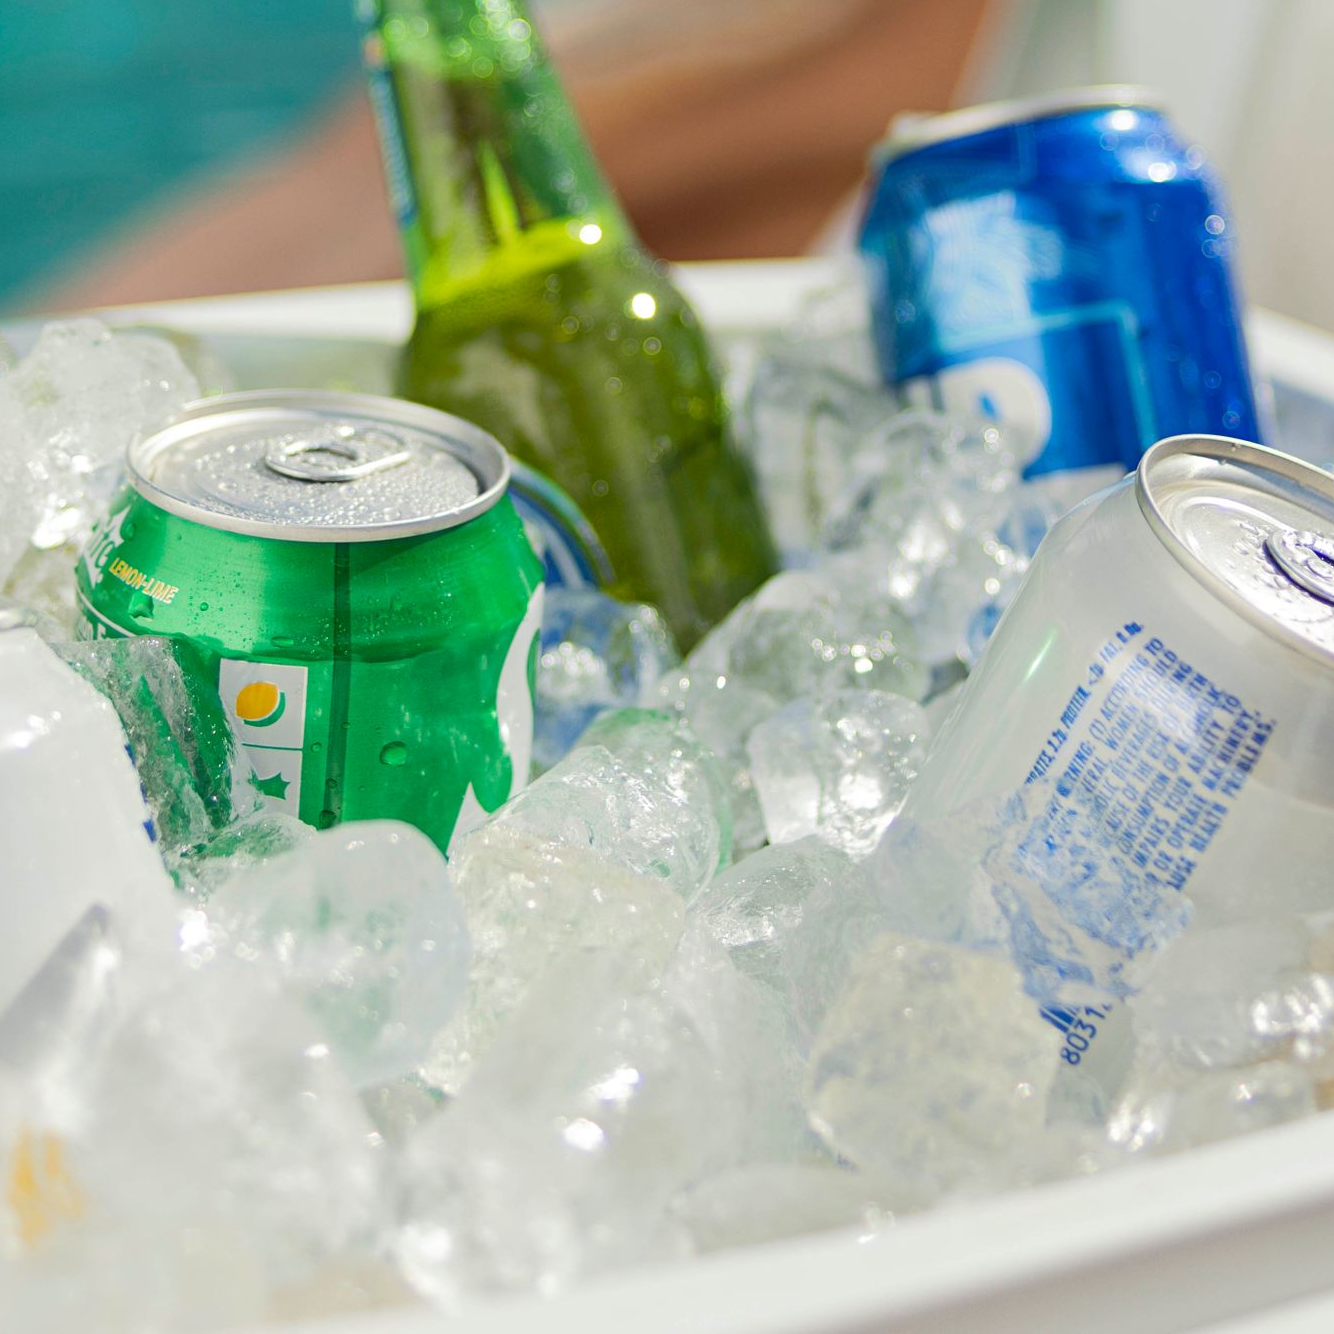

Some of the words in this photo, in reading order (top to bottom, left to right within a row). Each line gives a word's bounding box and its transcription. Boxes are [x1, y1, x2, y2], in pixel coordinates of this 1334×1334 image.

[109, 557, 180, 604] LEMON-LIME
[1098, 653, 1150, 722] ACCORDING
[1143, 635, 1165, 656] TO
[1102, 702, 1139, 751] WOMEN
[1133, 648, 1178, 702] SHOULD
[1113, 769, 1171, 855] CONSUMPTION
[1162, 753, 1180, 772] OF
[1120, 781, 1139, 801] OF
[1131, 757, 1153, 783] THE
[1144, 729, 1170, 760] RISK
[1130, 813, 1171, 868] IMPAIRS
[1161, 775, 1193, 812] YOUR
[1186, 718, 1223, 774] ABILITY
[1219, 693, 1241, 716] TO
[1152, 849, 1173, 873] OR
[1165, 792, 1207, 850] OPERATE
[1187, 799, 1228, 854] HEALTH
